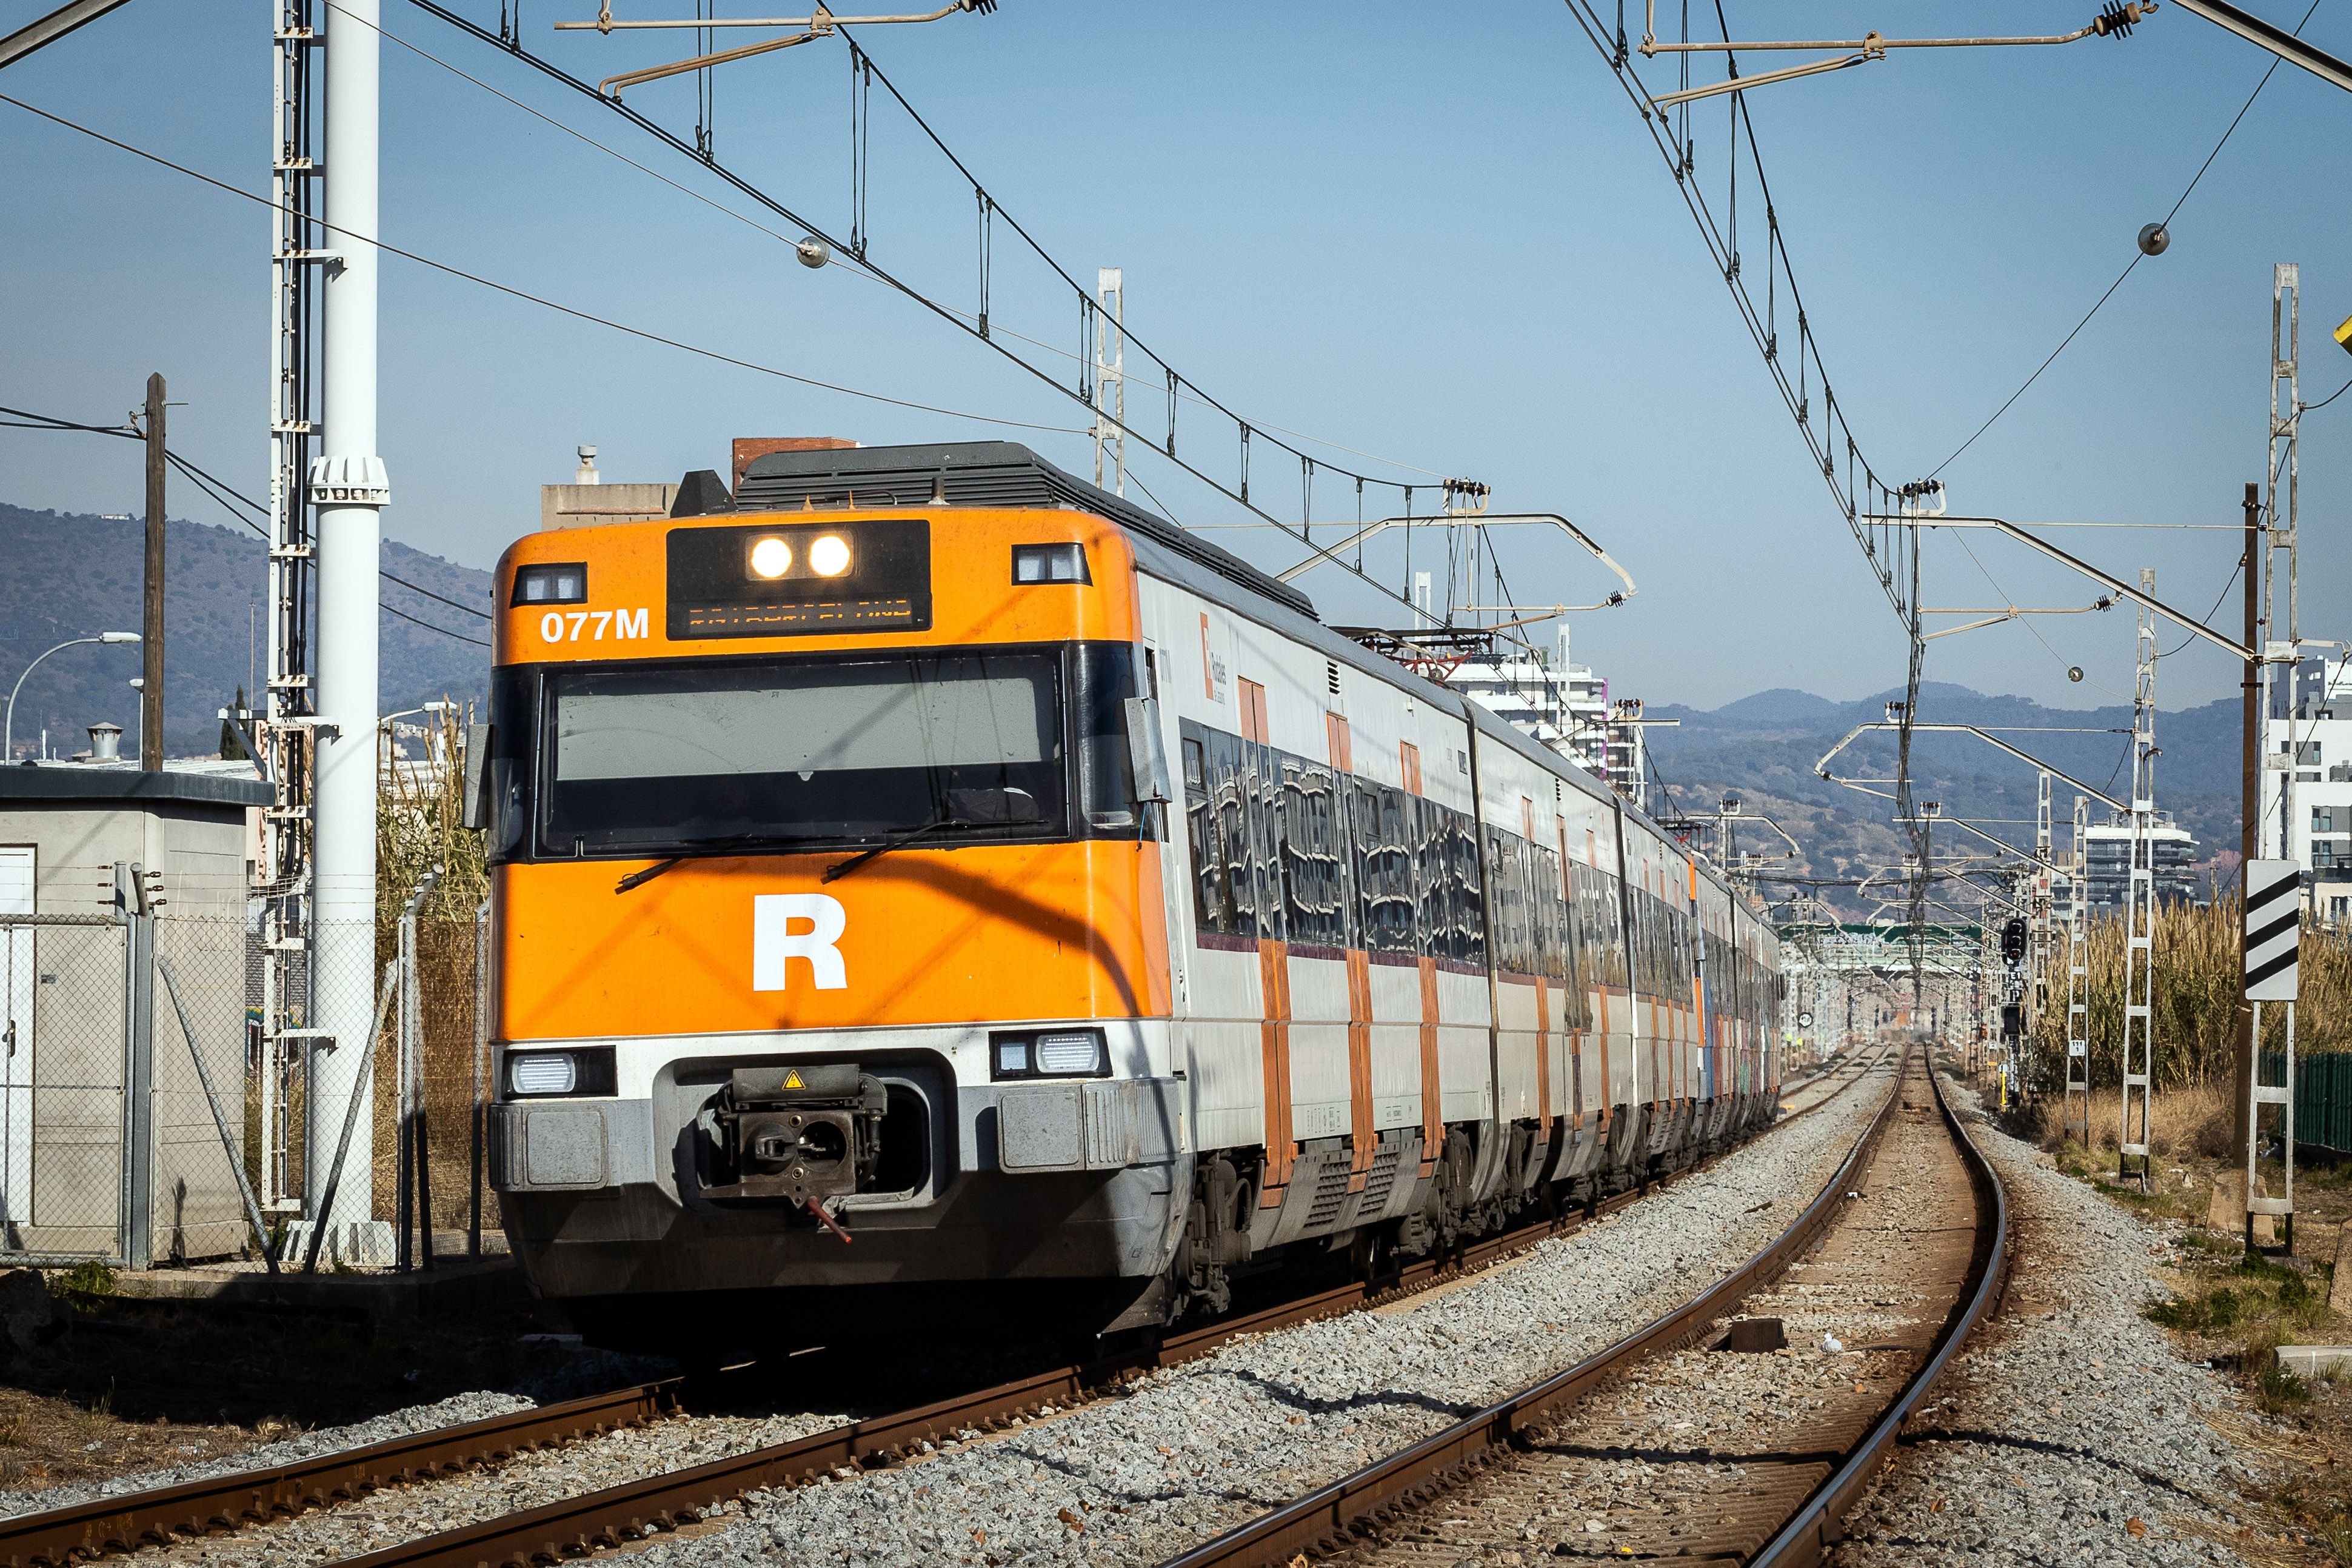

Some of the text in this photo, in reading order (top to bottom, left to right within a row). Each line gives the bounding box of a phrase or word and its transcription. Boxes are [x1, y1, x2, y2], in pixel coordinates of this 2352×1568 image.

[541, 608, 649, 643] 077M
[753, 893, 848, 992] R
[2012, 990, 2020, 1002] P
